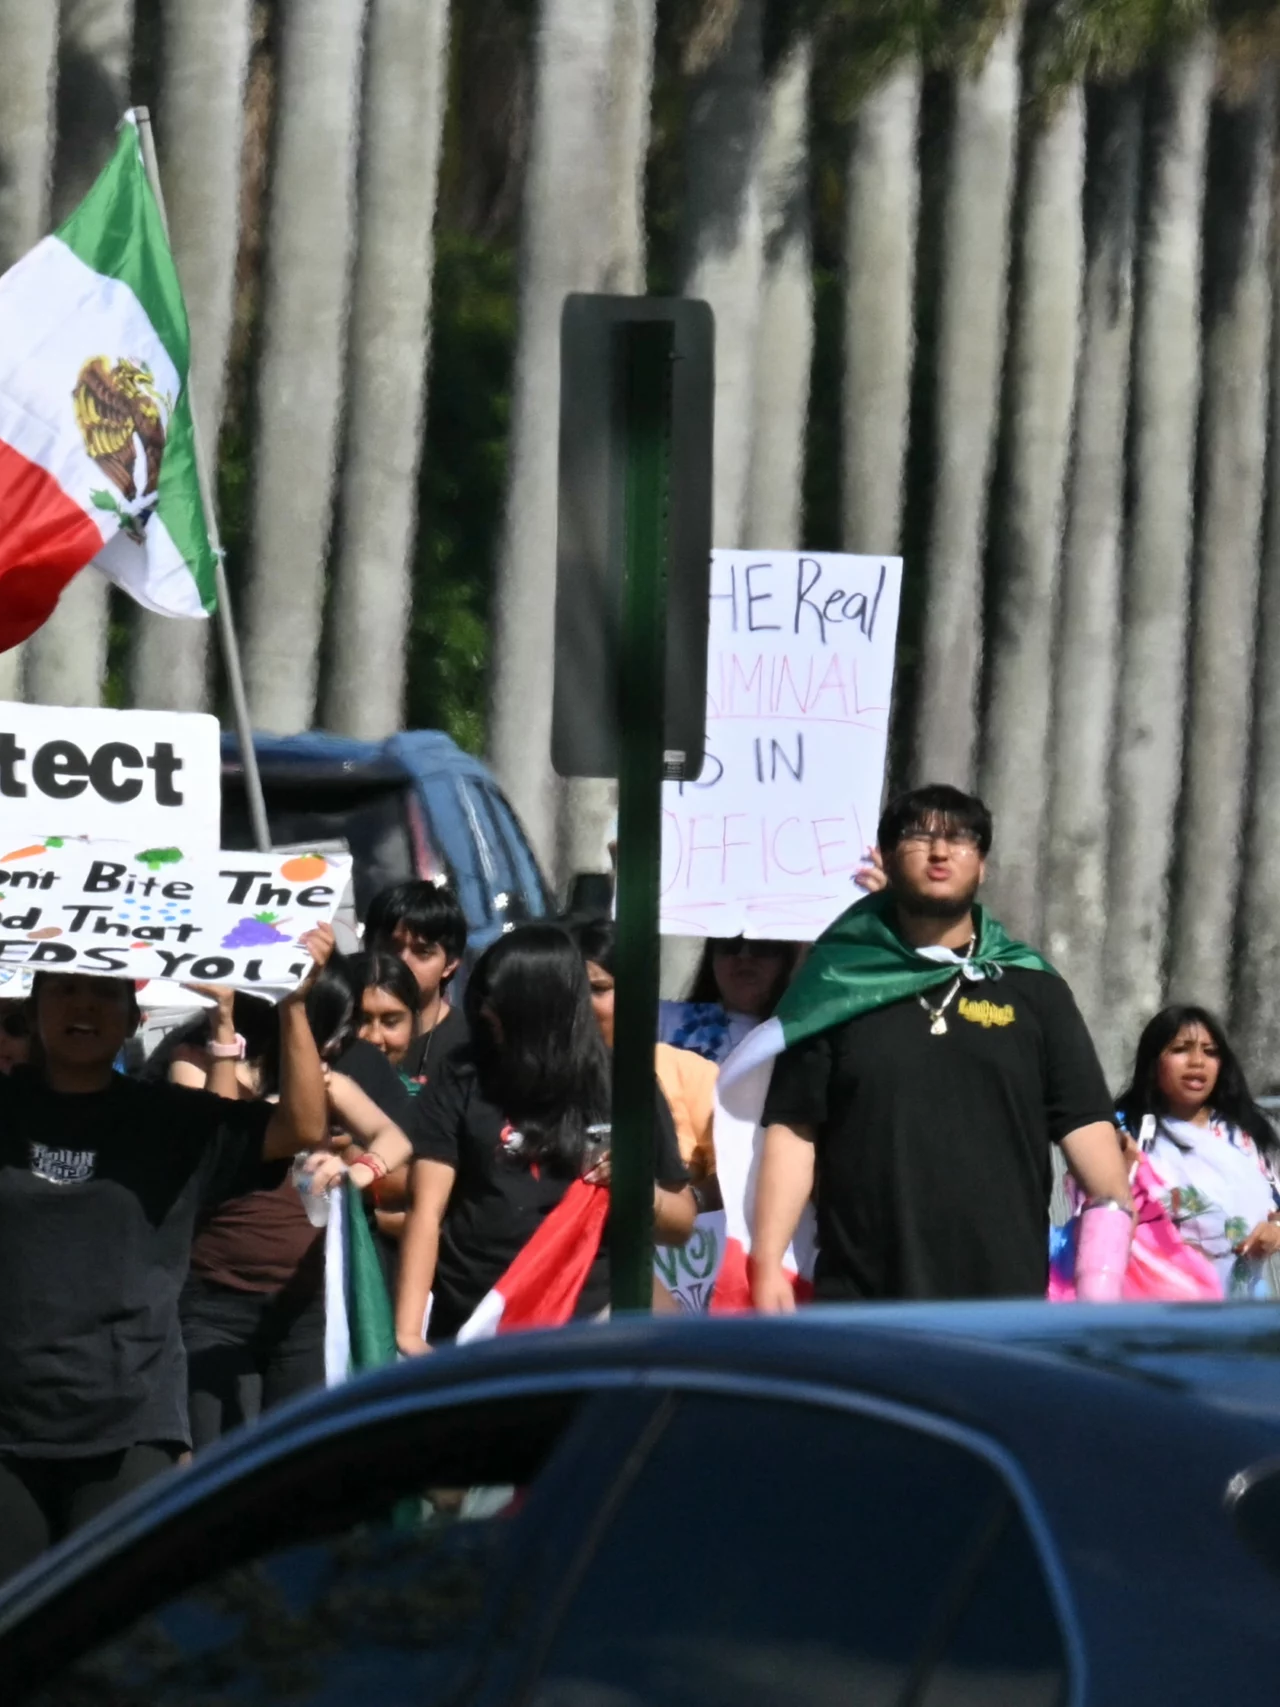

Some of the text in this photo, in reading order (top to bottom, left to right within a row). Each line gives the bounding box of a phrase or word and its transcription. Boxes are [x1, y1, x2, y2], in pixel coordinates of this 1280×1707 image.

[709, 558, 886, 643] HE Real
[708, 651, 888, 718] IMINAL
[754, 730, 805, 783] IN
[82, 860, 195, 901] Bite
[219, 869, 335, 908] The
[62, 904, 203, 943] That
